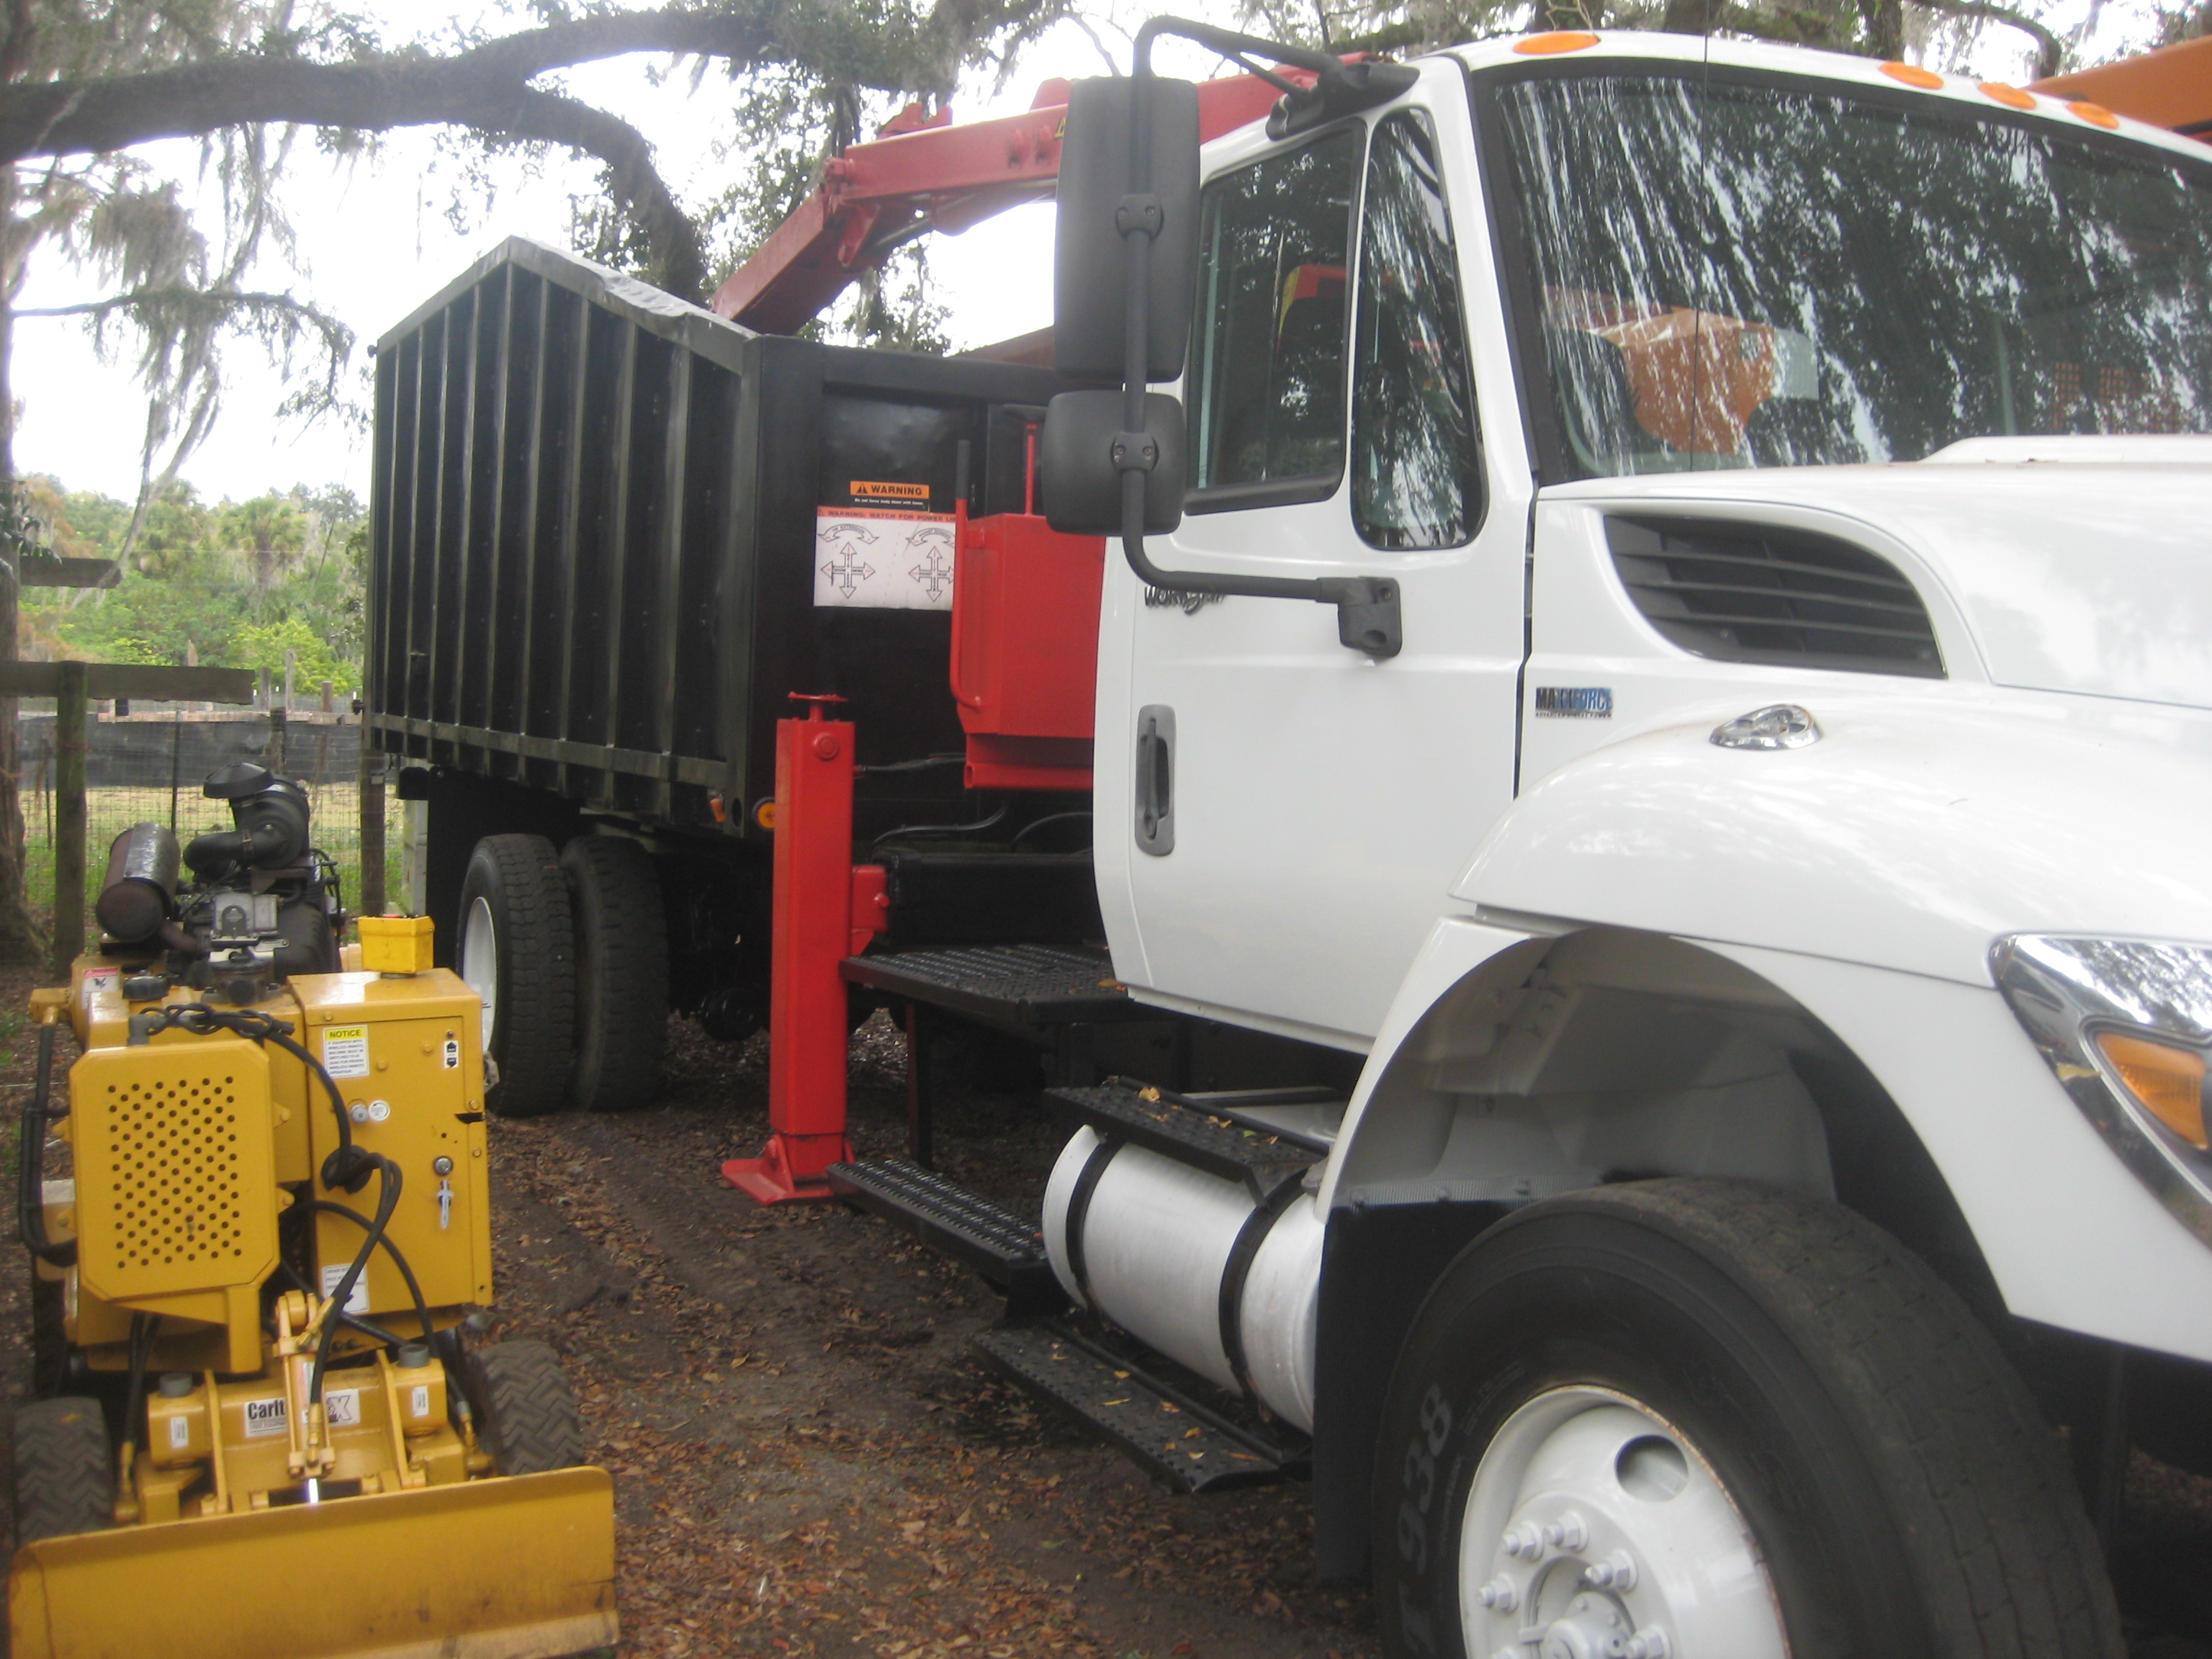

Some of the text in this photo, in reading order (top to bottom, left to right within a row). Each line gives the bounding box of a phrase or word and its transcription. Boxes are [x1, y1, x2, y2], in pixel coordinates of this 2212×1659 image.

[871, 485, 922, 495] WARNING
[1535, 687, 1614, 711] MAXXFORCE
[329, 1029, 362, 1038] NOTICE
